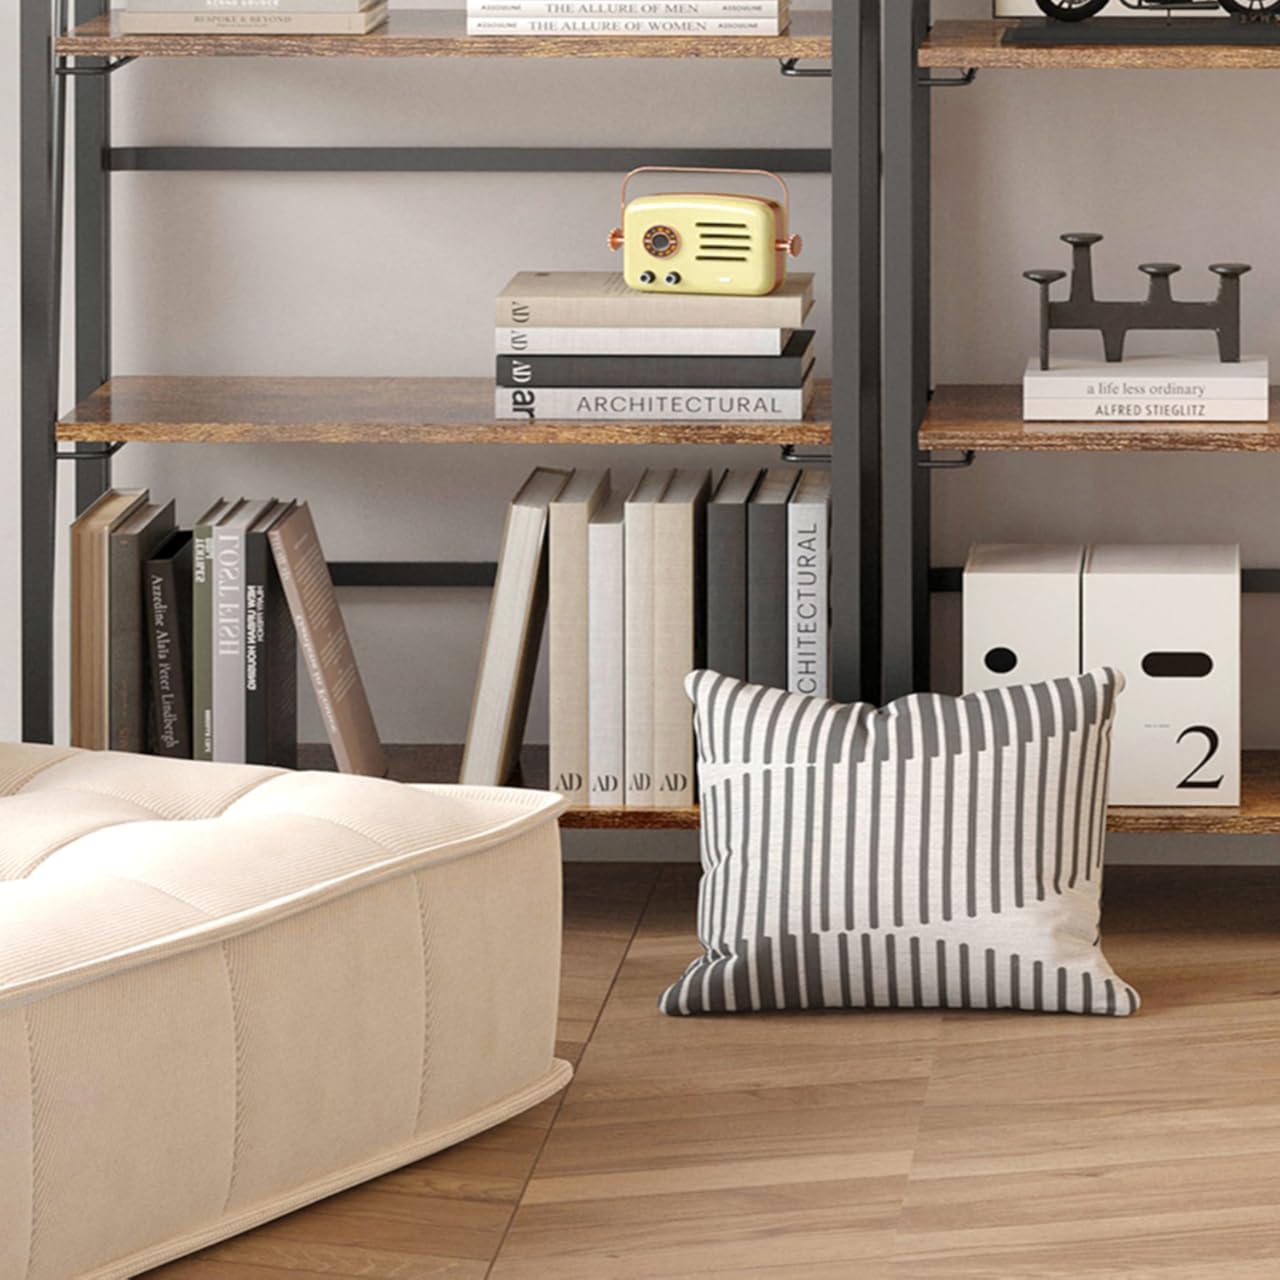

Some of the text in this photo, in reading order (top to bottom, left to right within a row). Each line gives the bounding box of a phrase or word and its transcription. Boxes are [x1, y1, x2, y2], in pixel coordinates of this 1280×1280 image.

[545, 3, 699, 13] THE ALLURE OF MEN
[529, 21, 707, 31] THE ALLURE OF WOMEN
[511, 301, 530, 324] AD
[511, 329, 528, 351] AD
[511, 360, 532, 383] AD
[1087, 382, 1206, 398] a life less ordinary
[511, 389, 536, 421] ar
[576, 395, 783, 414] ARCHITECTURAL
[1095, 404, 1206, 417] ALFRED STIEGLITZ
[151, 574, 169, 627] Azzedine
[797, 523, 818, 695] CHITECTURAL
[159, 661, 173, 692] Peter
[161, 693, 180, 749] Lindbergh
[1175, 724, 1225, 789] 2
[555, 773, 583, 791] AD
[592, 774, 619, 792] AD
[628, 773, 651, 791] AD
[659, 773, 688, 791] AD
